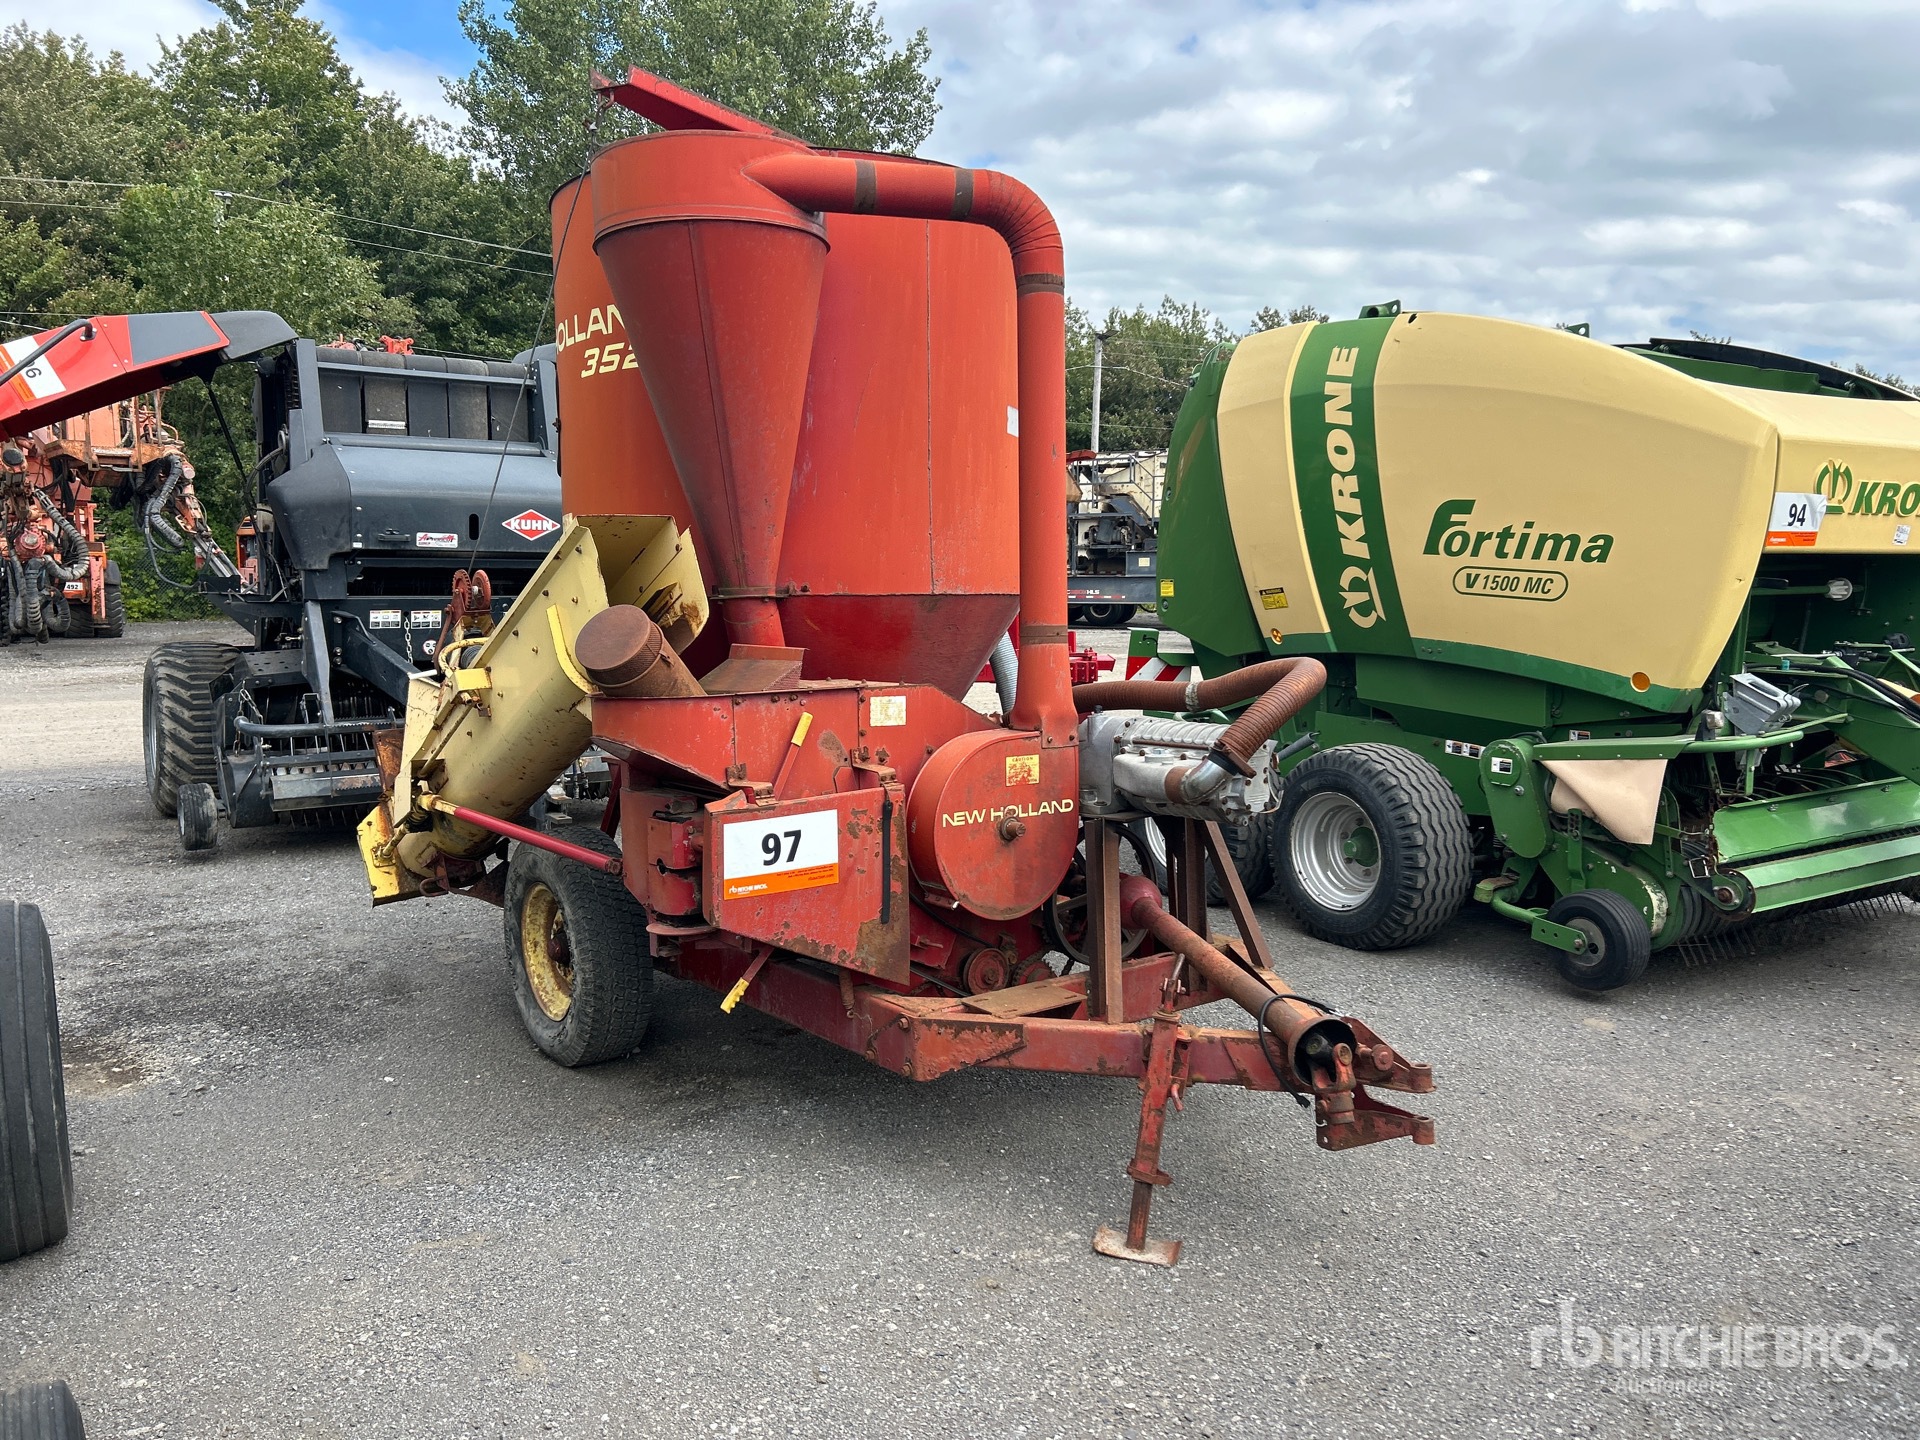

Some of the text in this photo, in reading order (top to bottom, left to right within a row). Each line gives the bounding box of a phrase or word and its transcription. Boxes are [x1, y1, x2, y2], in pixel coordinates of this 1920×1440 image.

[556, 304, 626, 355] OLLAN
[1324, 346, 1371, 560] KRONE
[1787, 503, 1807, 527] 94
[1852, 480, 1920, 516] KRO
[510, 518, 553, 531] KUHN
[1422, 499, 1615, 564] Fortima
[1465, 572, 1555, 595] V 1500 MC
[942, 798, 1074, 828] NEW HOLLAND
[761, 829, 802, 867] 97
